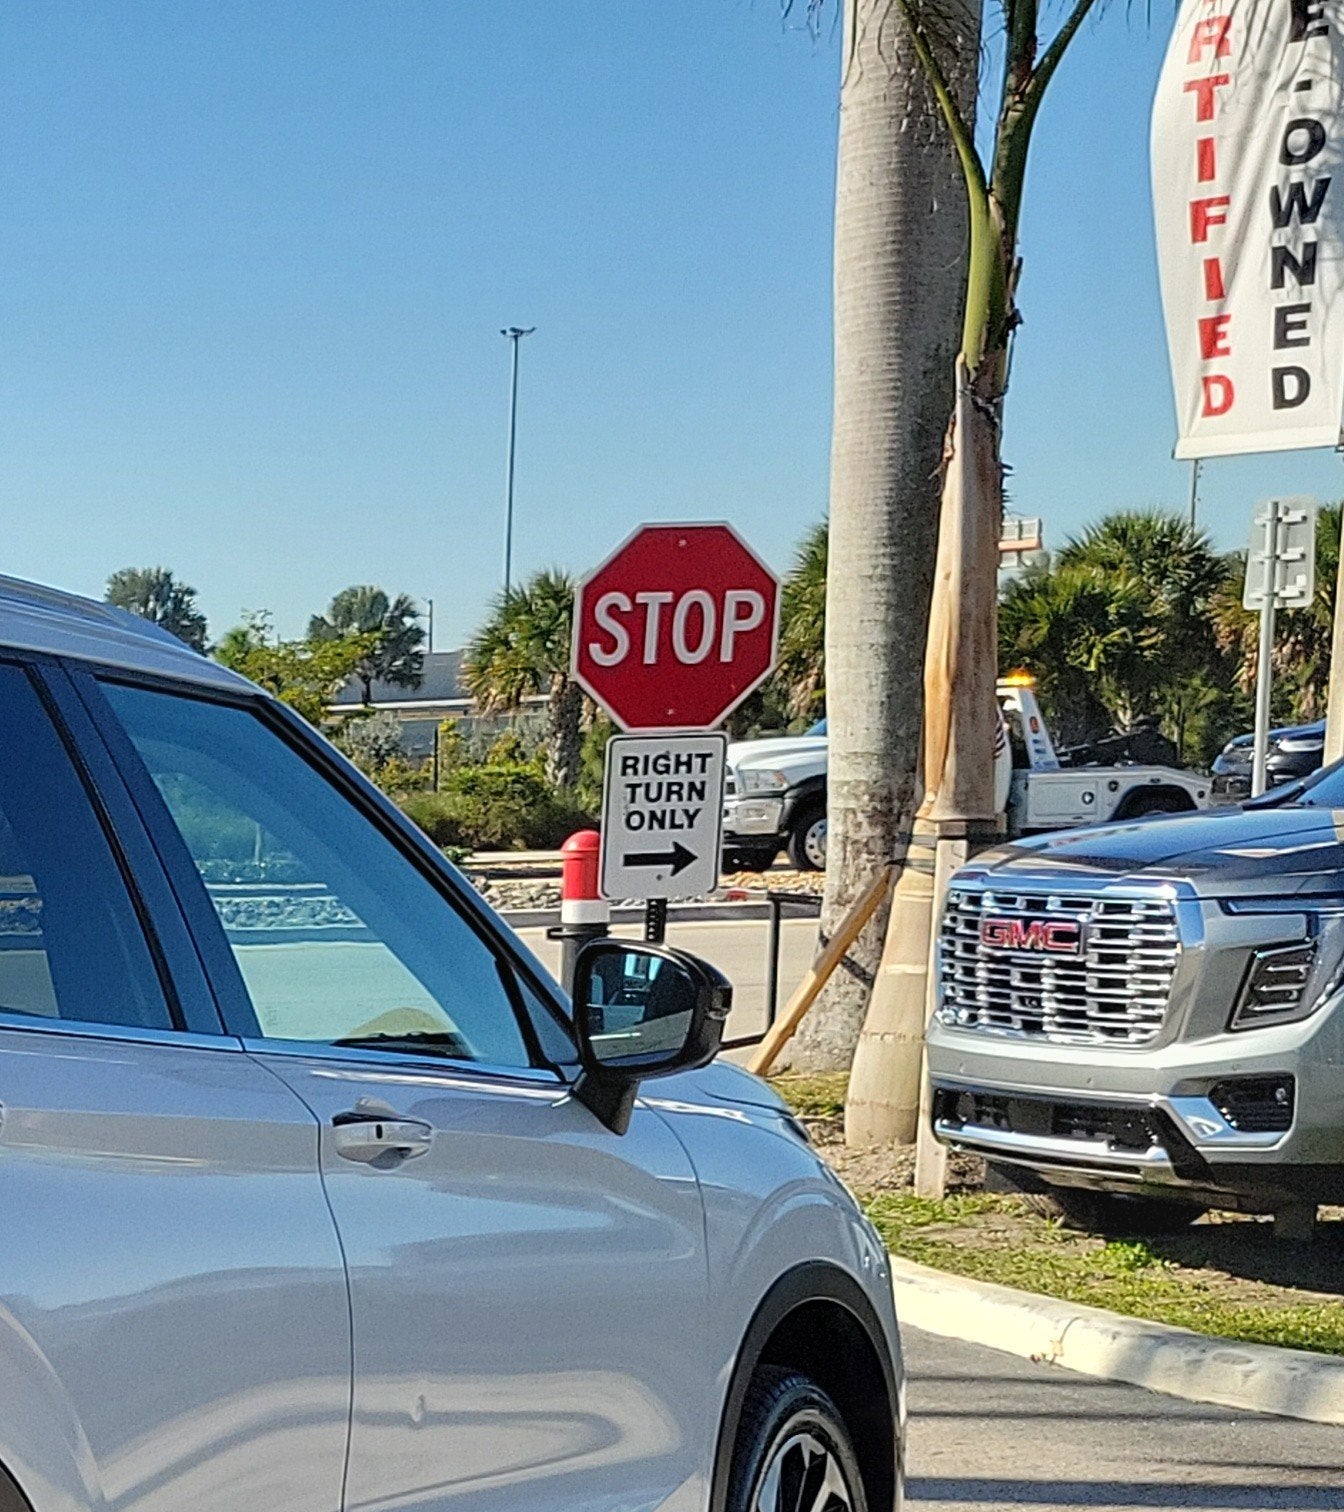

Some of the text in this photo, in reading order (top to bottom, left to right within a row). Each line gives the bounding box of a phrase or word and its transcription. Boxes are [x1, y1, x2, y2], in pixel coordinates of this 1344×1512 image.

[1183, 0, 1234, 418] RTIFIED
[588, 588, 765, 667] STOP
[620, 752, 713, 777] RIGHT
[624, 780, 707, 804] TURN
[624, 808, 703, 832] ONLY
[980, 920, 1080, 952] GMC
